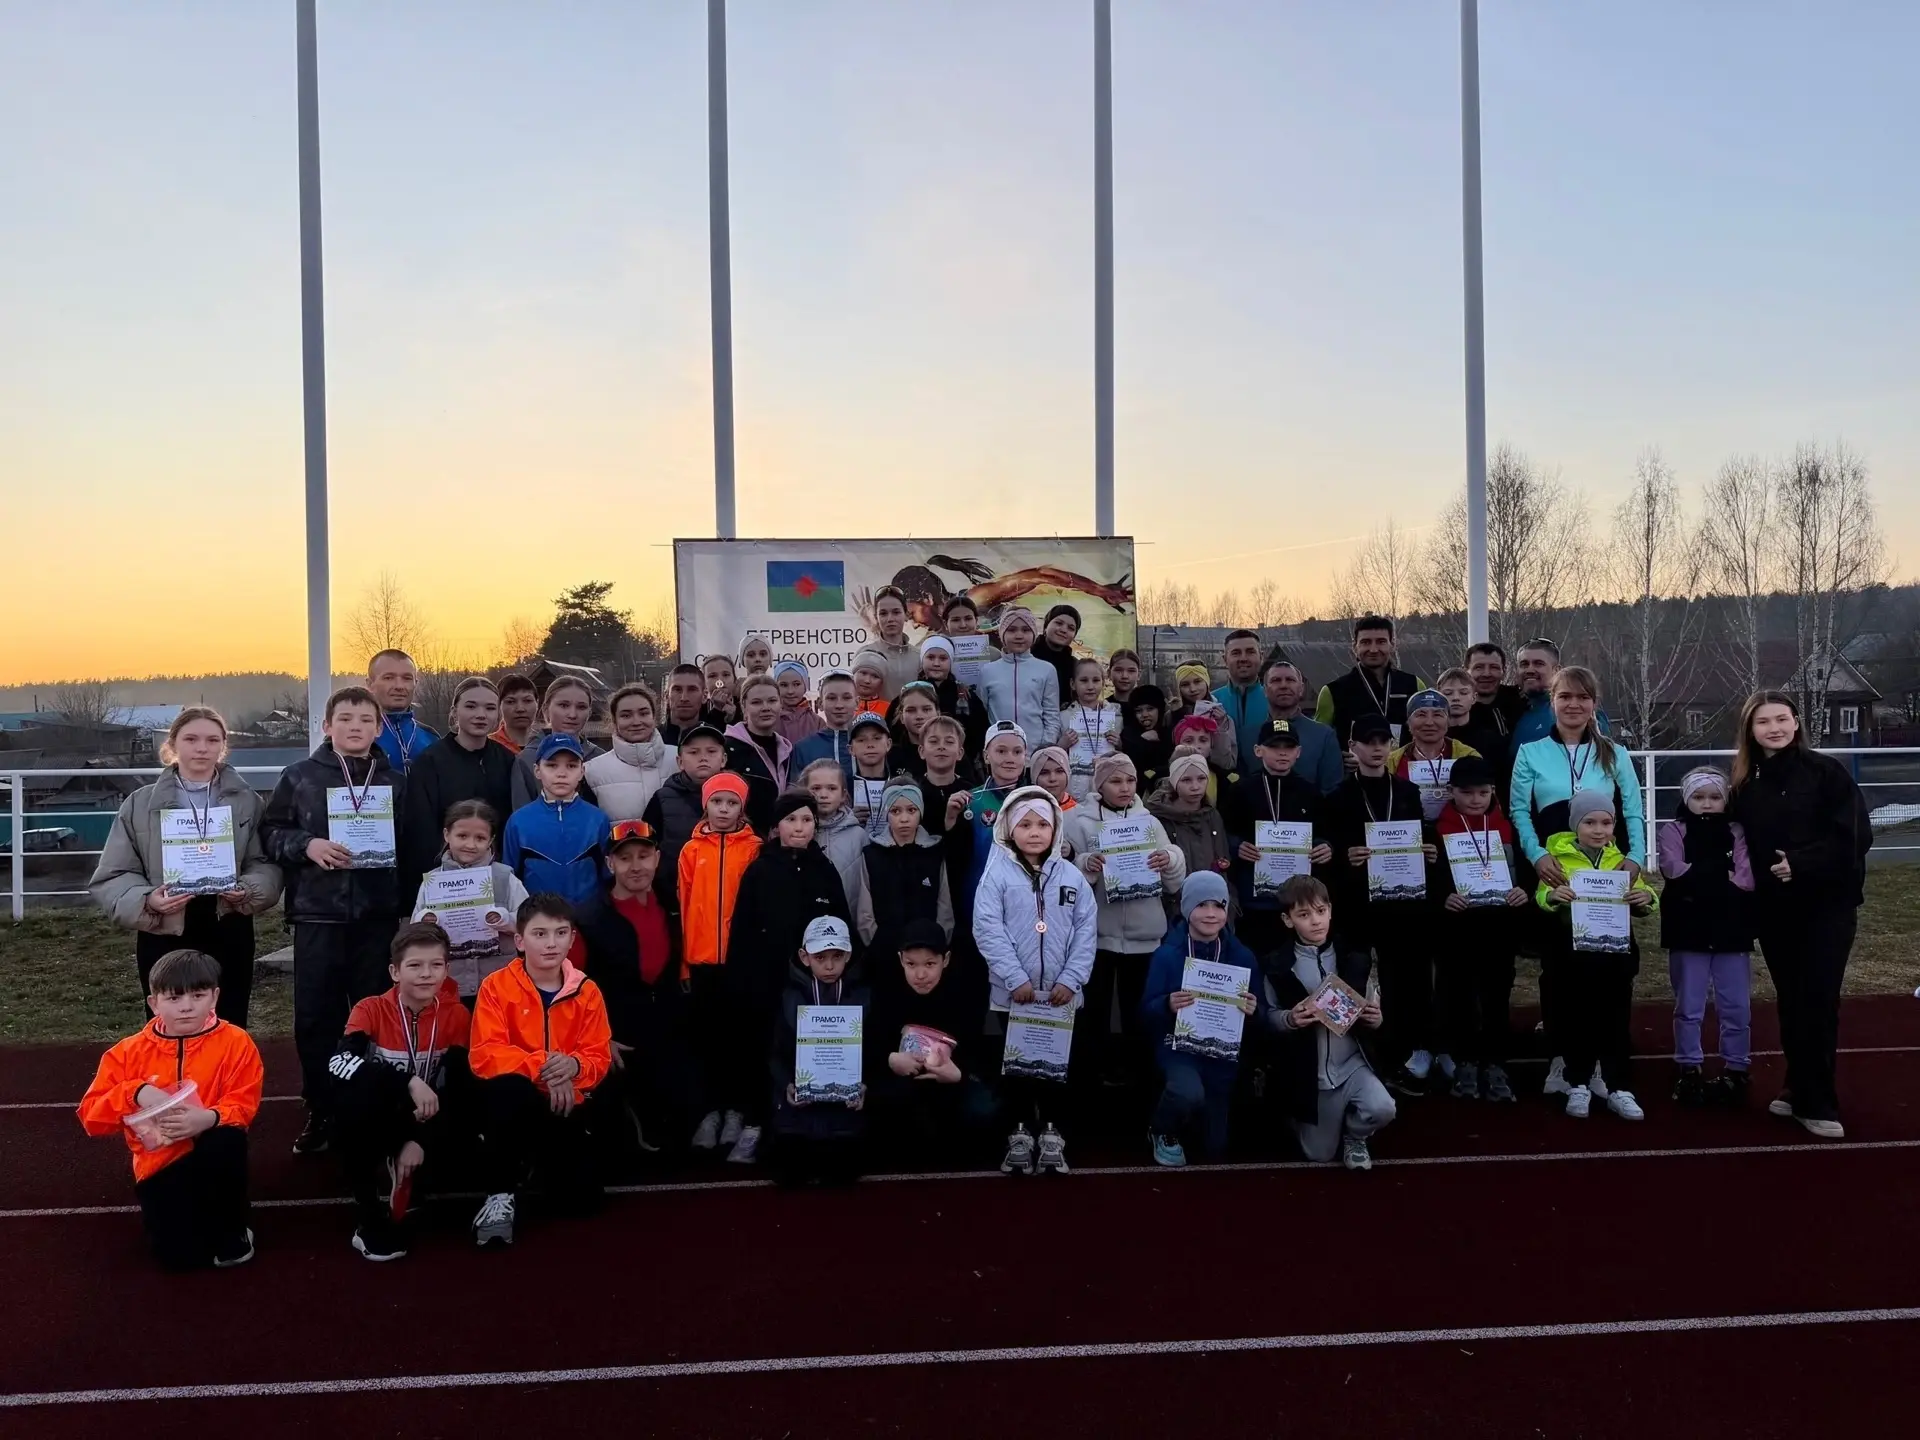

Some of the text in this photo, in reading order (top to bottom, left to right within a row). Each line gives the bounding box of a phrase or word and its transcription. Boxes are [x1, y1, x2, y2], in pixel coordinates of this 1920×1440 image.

[1110, 826, 1140, 835] ГРАМОТА
[1378, 829, 1408, 837] ГРАМОТА
[438, 878, 475, 889] ГРАМОТА
[1583, 877, 1614, 886] ГРАМОТА
[1197, 969, 1233, 982] ГРАМОТА
